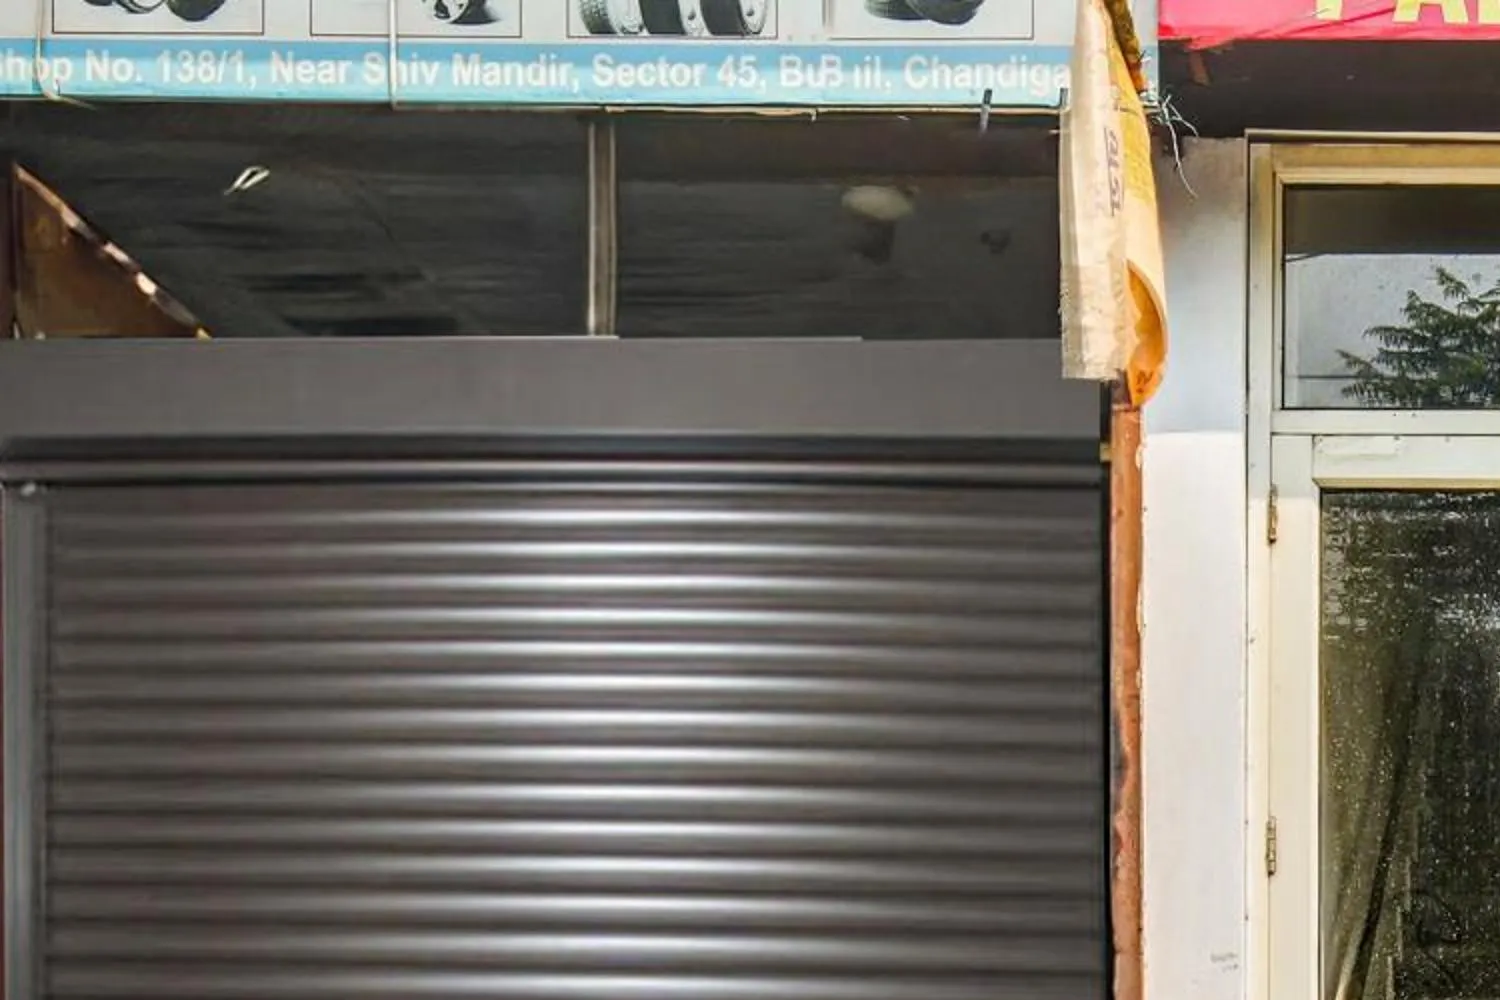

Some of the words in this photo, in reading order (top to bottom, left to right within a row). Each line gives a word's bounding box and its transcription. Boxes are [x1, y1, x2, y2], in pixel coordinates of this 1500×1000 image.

[0, 48, 73, 92] hop
[84, 50, 143, 83] No.
[156, 50, 257, 90] 138/1,
[270, 53, 352, 84] Near
[362, 52, 440, 86] Shiv
[450, 52, 580, 93] Mandir,
[591, 53, 706, 88] Sector
[716, 55, 767, 94] 45,
